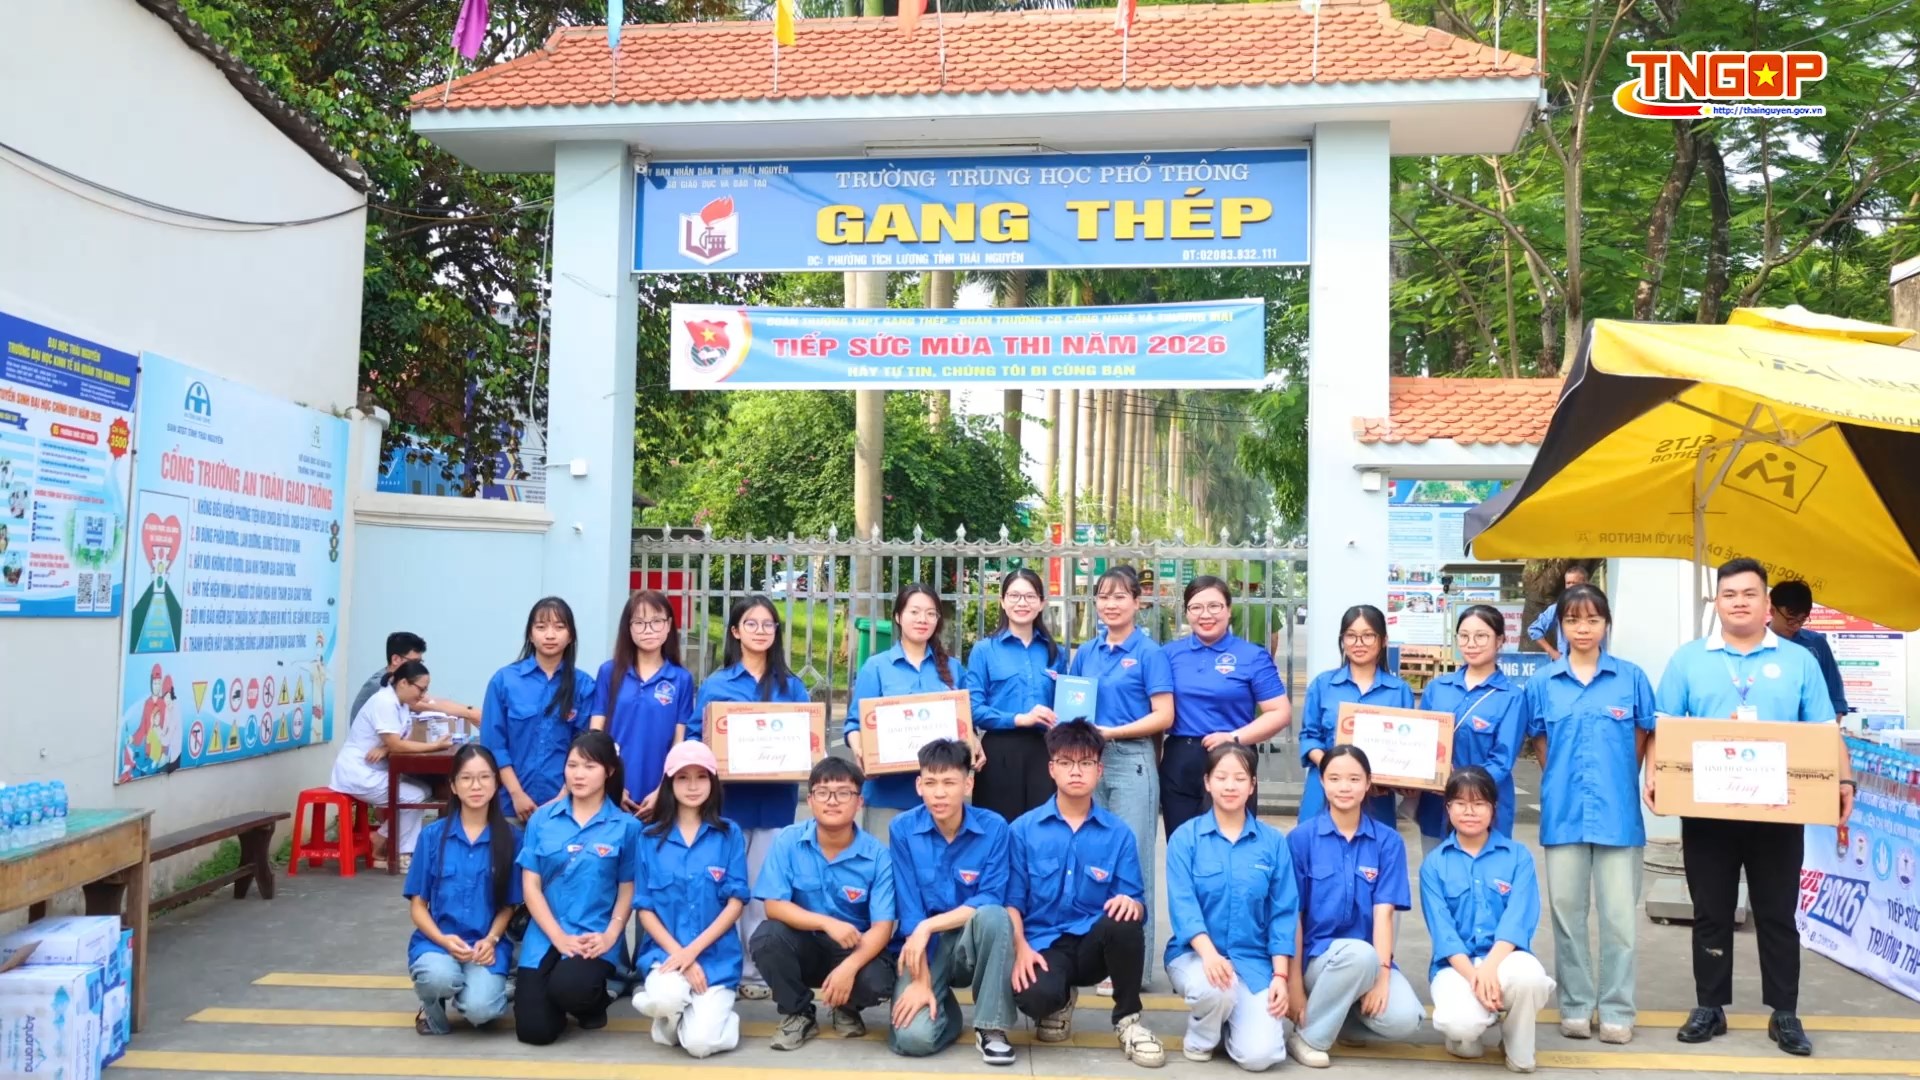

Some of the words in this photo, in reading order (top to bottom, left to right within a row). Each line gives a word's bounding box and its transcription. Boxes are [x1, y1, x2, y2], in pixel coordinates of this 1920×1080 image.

[656, 168, 671, 177] BAN
[759, 164, 789, 175] NGUYÊN
[836, 162, 936, 189] TRƯỜNG
[947, 166, 1032, 187] TRUNG
[1038, 166, 1092, 189] HỌC
[1100, 154, 1153, 185] PHỔ
[1159, 159, 1250, 183] THÔNG
[816, 201, 1030, 246] GANG
[1064, 186, 1274, 241] THÉP
[828, 252, 868, 266] PHƯỜNG
[872, 252, 893, 266] TÍCH
[934, 250, 955, 265] TỈNH
[959, 252, 981, 265] THÁI
[985, 250, 1025, 264] NGUYÊN
[773, 330, 840, 359] TIẾP
[848, 331, 911, 358] SỨC
[920, 332, 993, 358] MÙA
[1002, 335, 1050, 357] THI
[1062, 331, 1137, 356] NĂM
[1146, 334, 1228, 356] 2026
[906, 366, 937, 378] TIN,
[942, 364, 997, 378] CHÚNG
[1002, 363, 1026, 377] TÔI
[1052, 364, 1097, 377] CÙNG
[1102, 365, 1136, 378] BẠN
[161, 443, 195, 485] CỔNG
[198, 458, 241, 494] TRƯỜNG
[242, 470, 258, 497] AN
[260, 471, 285, 502] TOÀN
[286, 480, 306, 506] GIAO
[307, 482, 333, 512] THÔNG
[1811, 877, 1867, 931] 2026
[1866, 926, 1903, 965] TRƯỜNG
